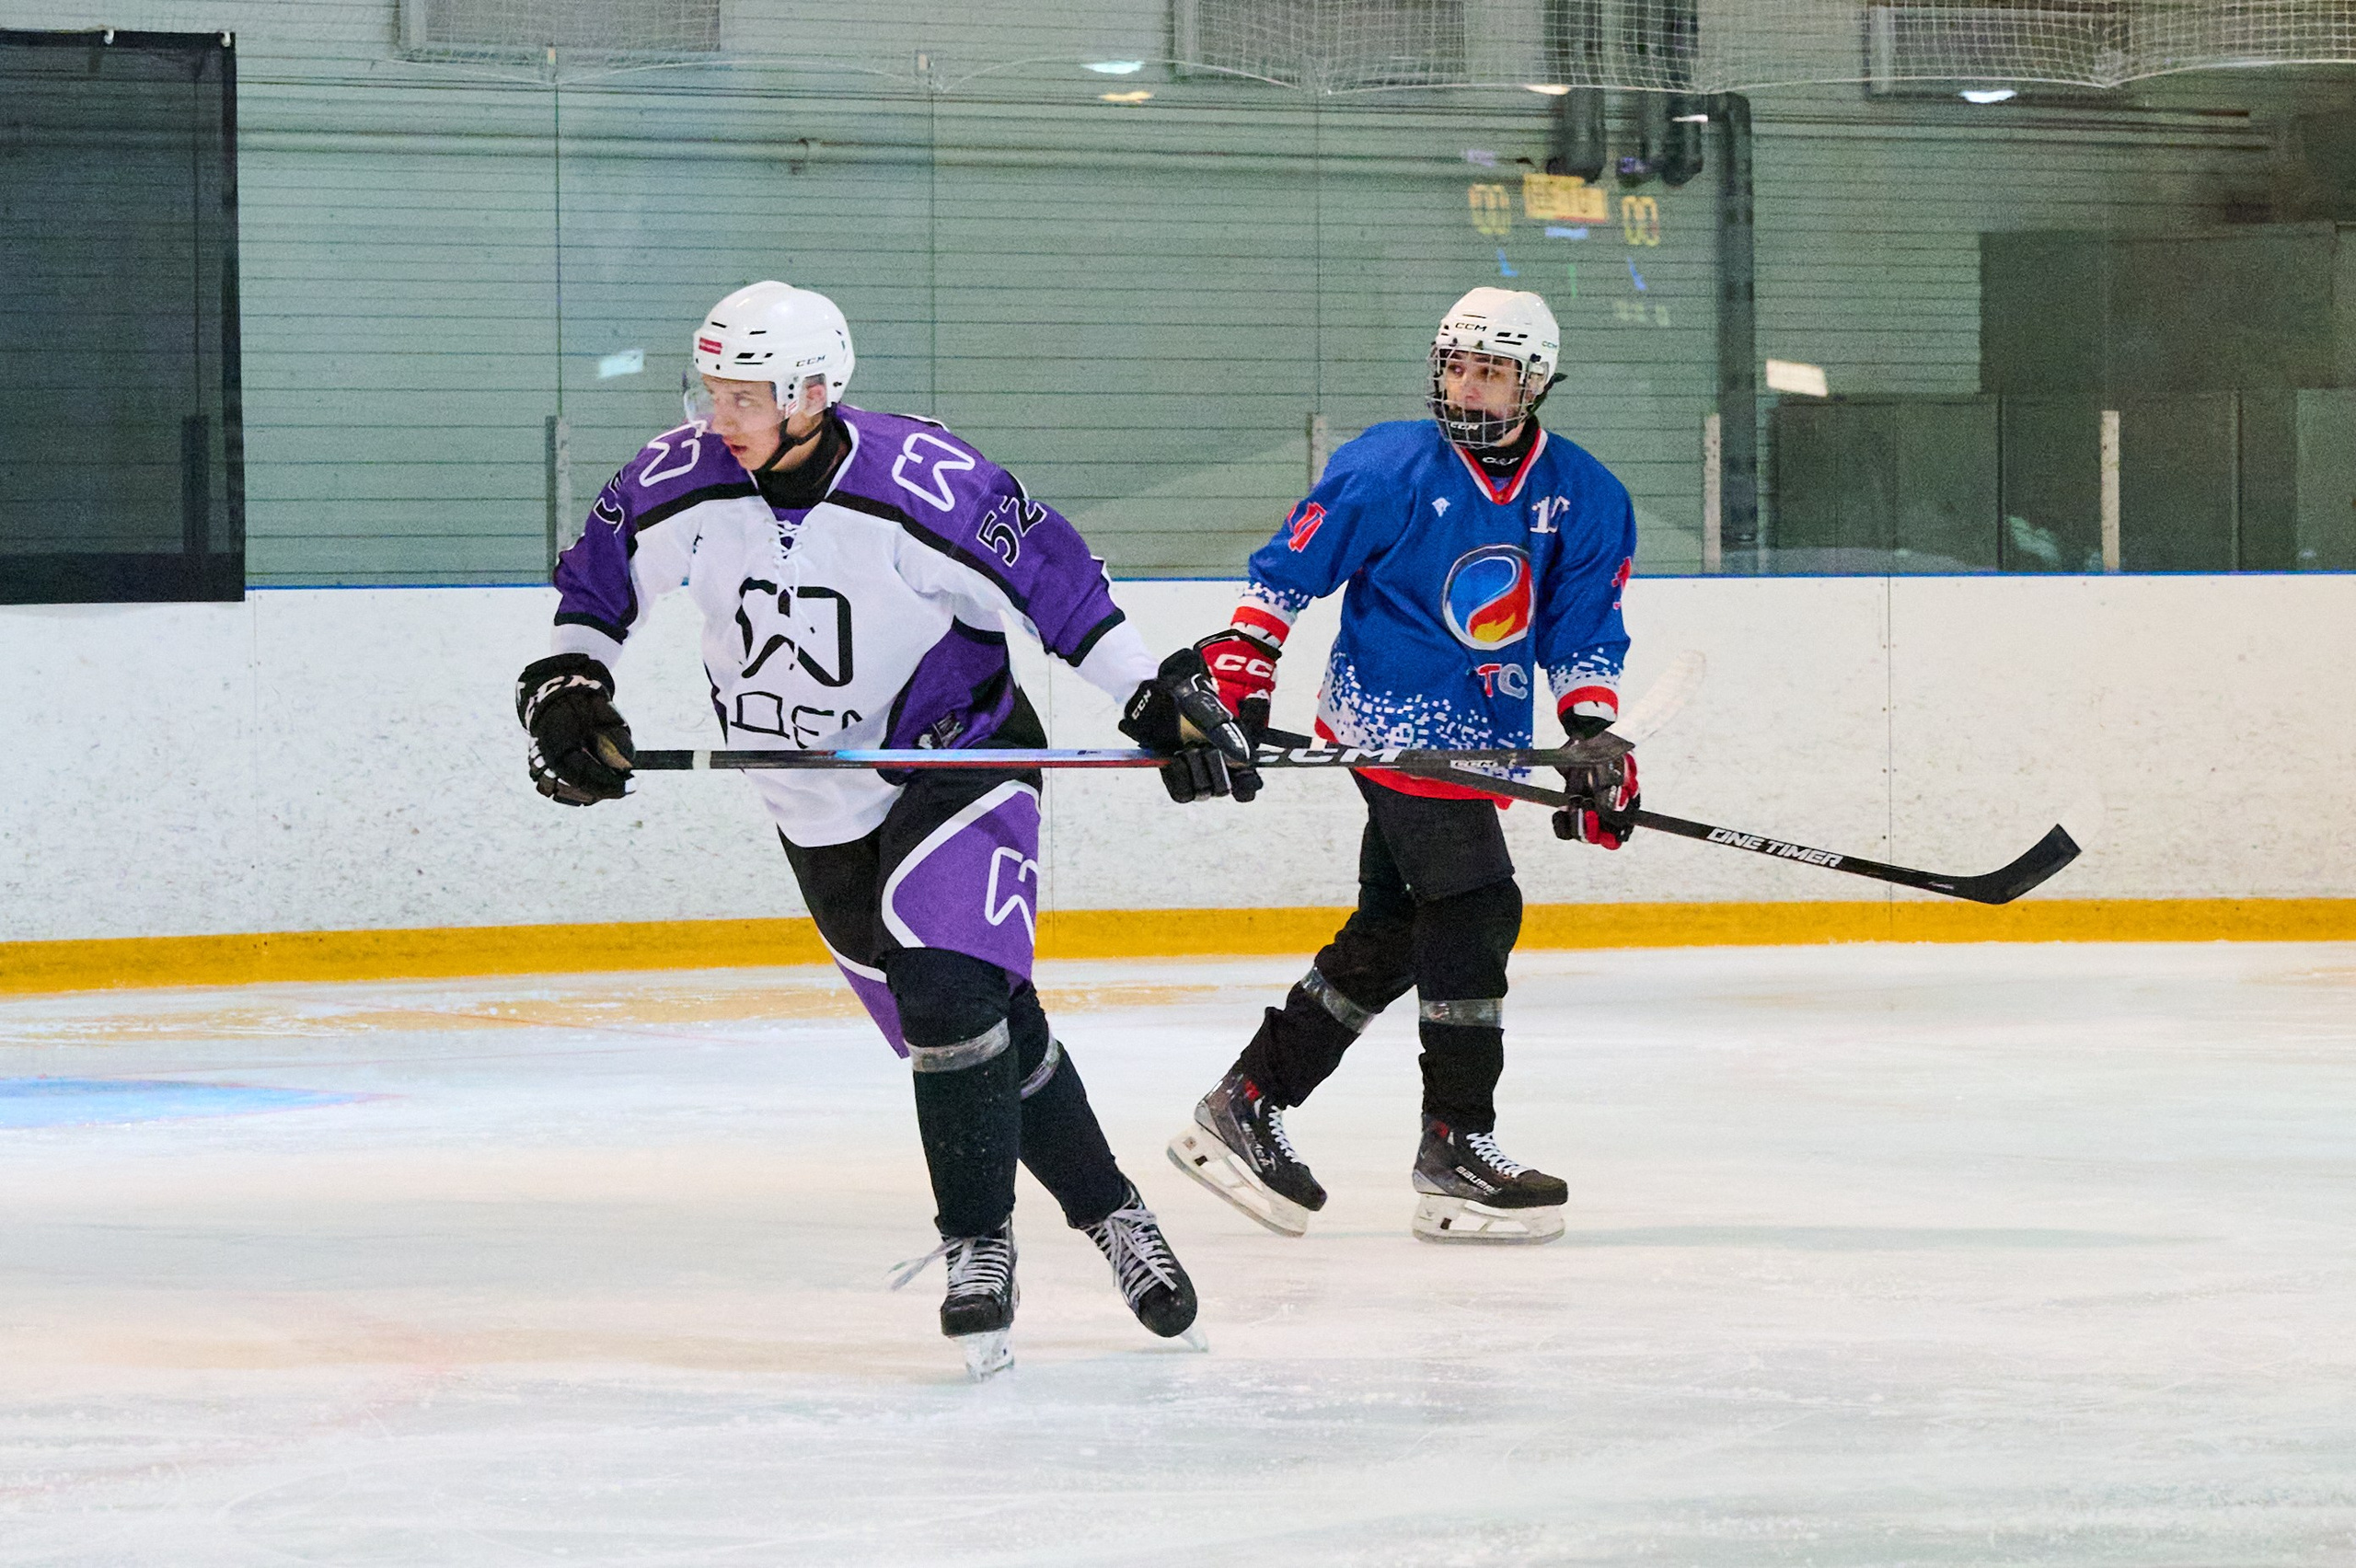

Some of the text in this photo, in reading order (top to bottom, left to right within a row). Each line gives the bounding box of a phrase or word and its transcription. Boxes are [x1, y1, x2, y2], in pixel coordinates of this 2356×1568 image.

[1455, 322, 1487, 332] CCM
[796, 355, 826, 367] CCM
[976, 495, 1047, 567] 52
[1214, 653, 1276, 679] CC
[1131, 689, 1152, 721] CCM
[1706, 828, 1843, 868] ONE TIMER
